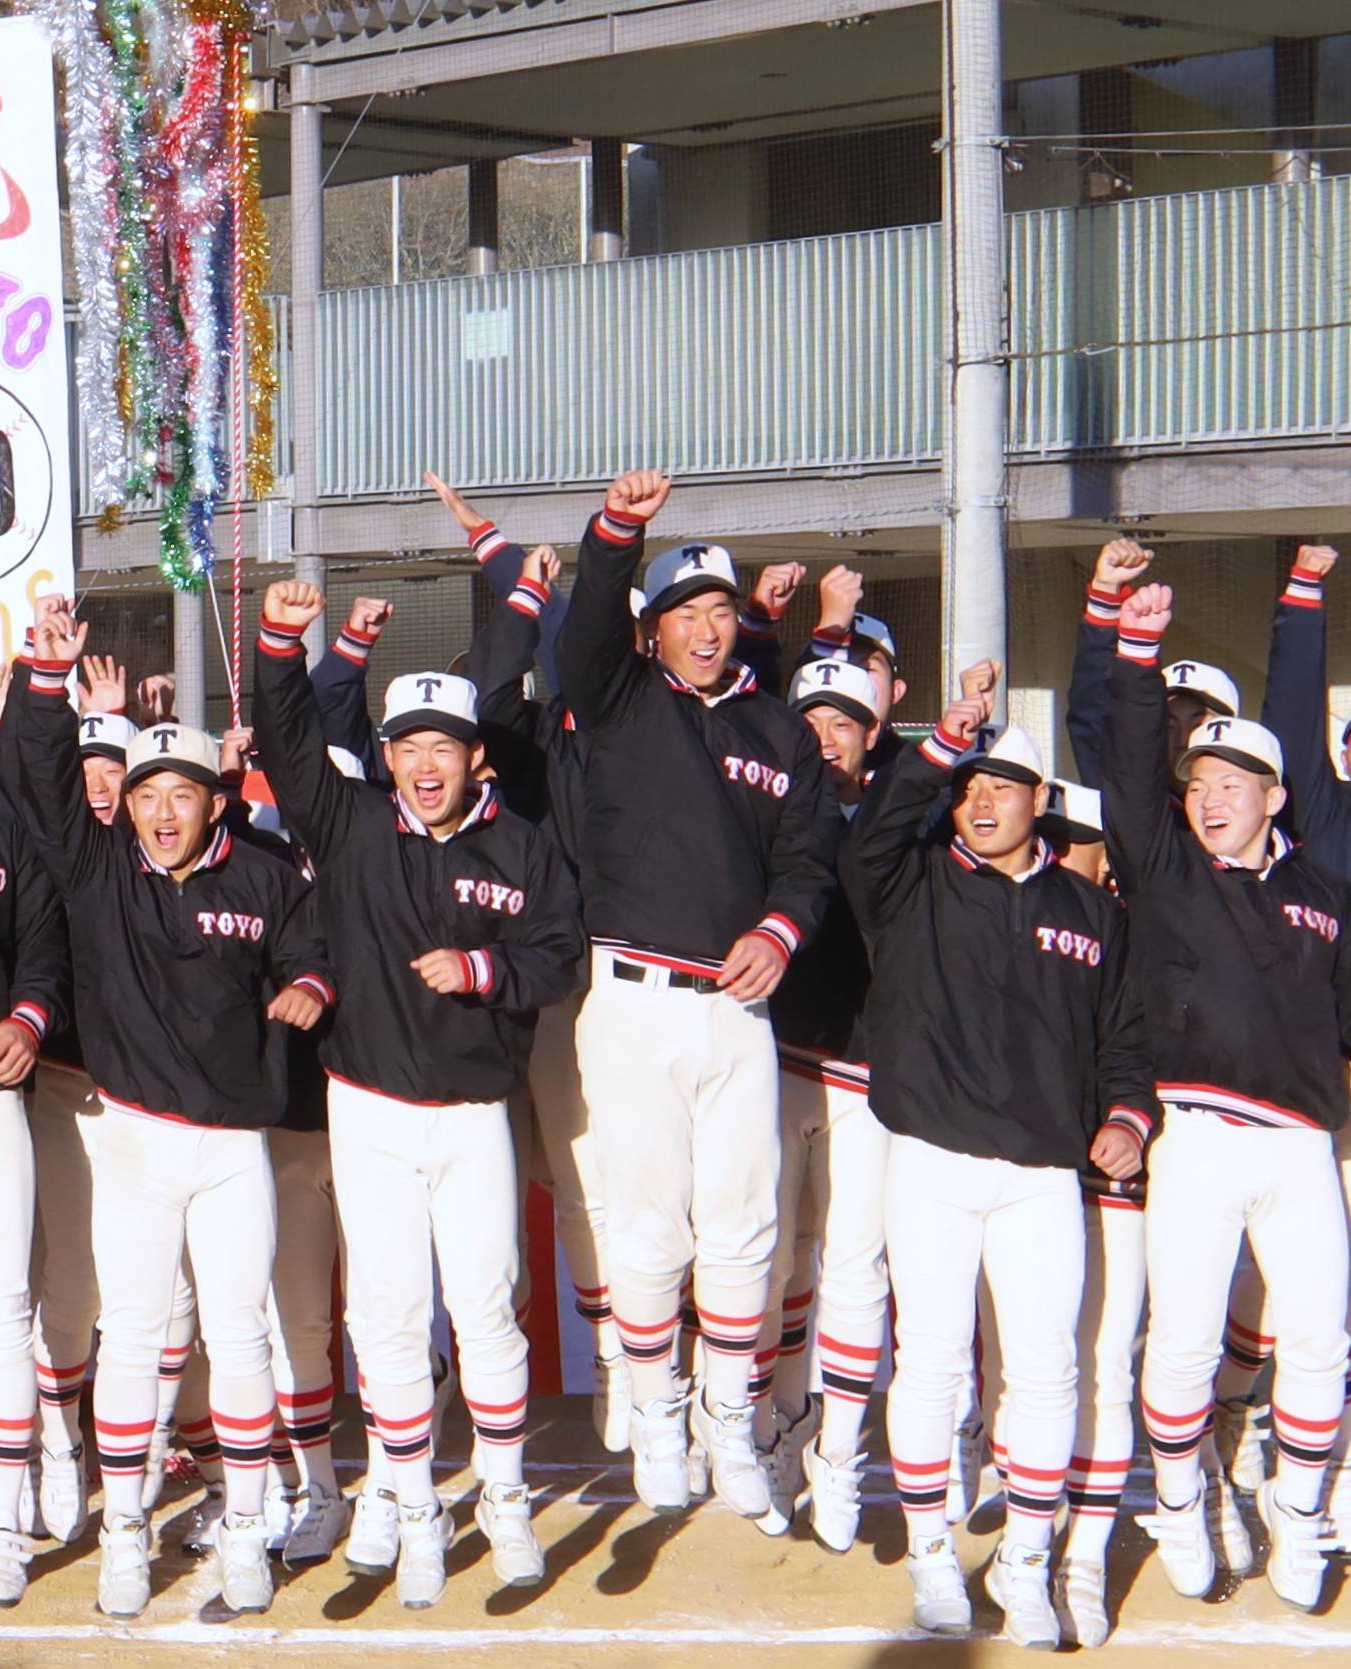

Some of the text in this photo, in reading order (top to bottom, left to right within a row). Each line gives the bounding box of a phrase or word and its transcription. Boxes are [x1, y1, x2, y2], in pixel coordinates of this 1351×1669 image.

[682, 546, 709, 570] T
[816, 663, 841, 685] T
[1173, 663, 1196, 684] T
[416, 677, 442, 703] T
[81, 716, 104, 738] T
[1207, 720, 1231, 742] T
[153, 728, 178, 753] T
[723, 755, 791, 798] TOYO
[453, 877, 526, 916] TOYO
[197, 911, 265, 942] TOYO
[1282, 903, 1340, 944] TOYO
[1036, 926, 1102, 967] TOYO
